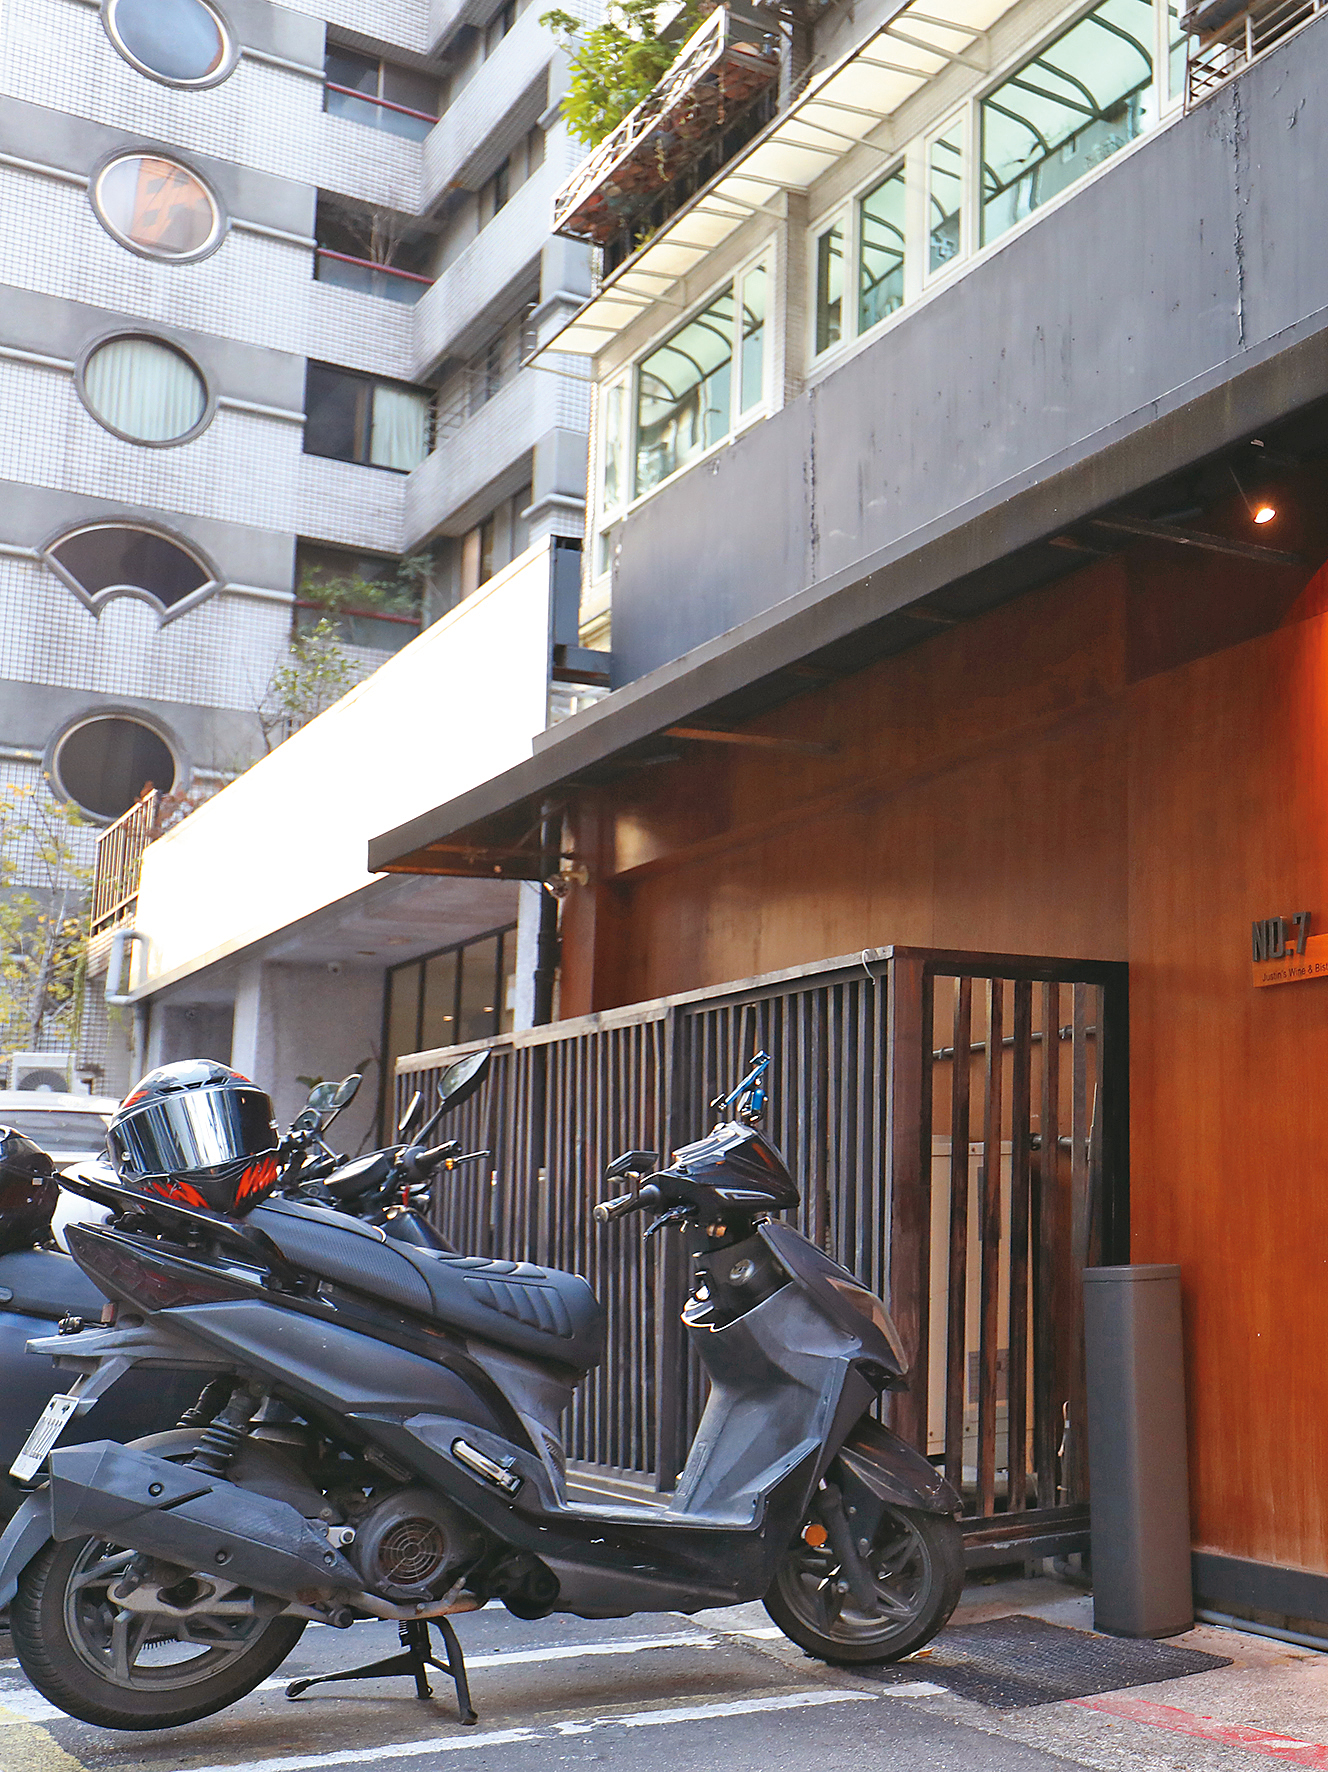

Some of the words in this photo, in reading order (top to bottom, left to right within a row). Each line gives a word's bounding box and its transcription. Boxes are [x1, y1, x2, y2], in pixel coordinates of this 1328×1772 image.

[1263, 970, 1287, 982] Justin's
[1289, 967, 1306, 977] Wine
[1307, 965, 1313, 973] &
